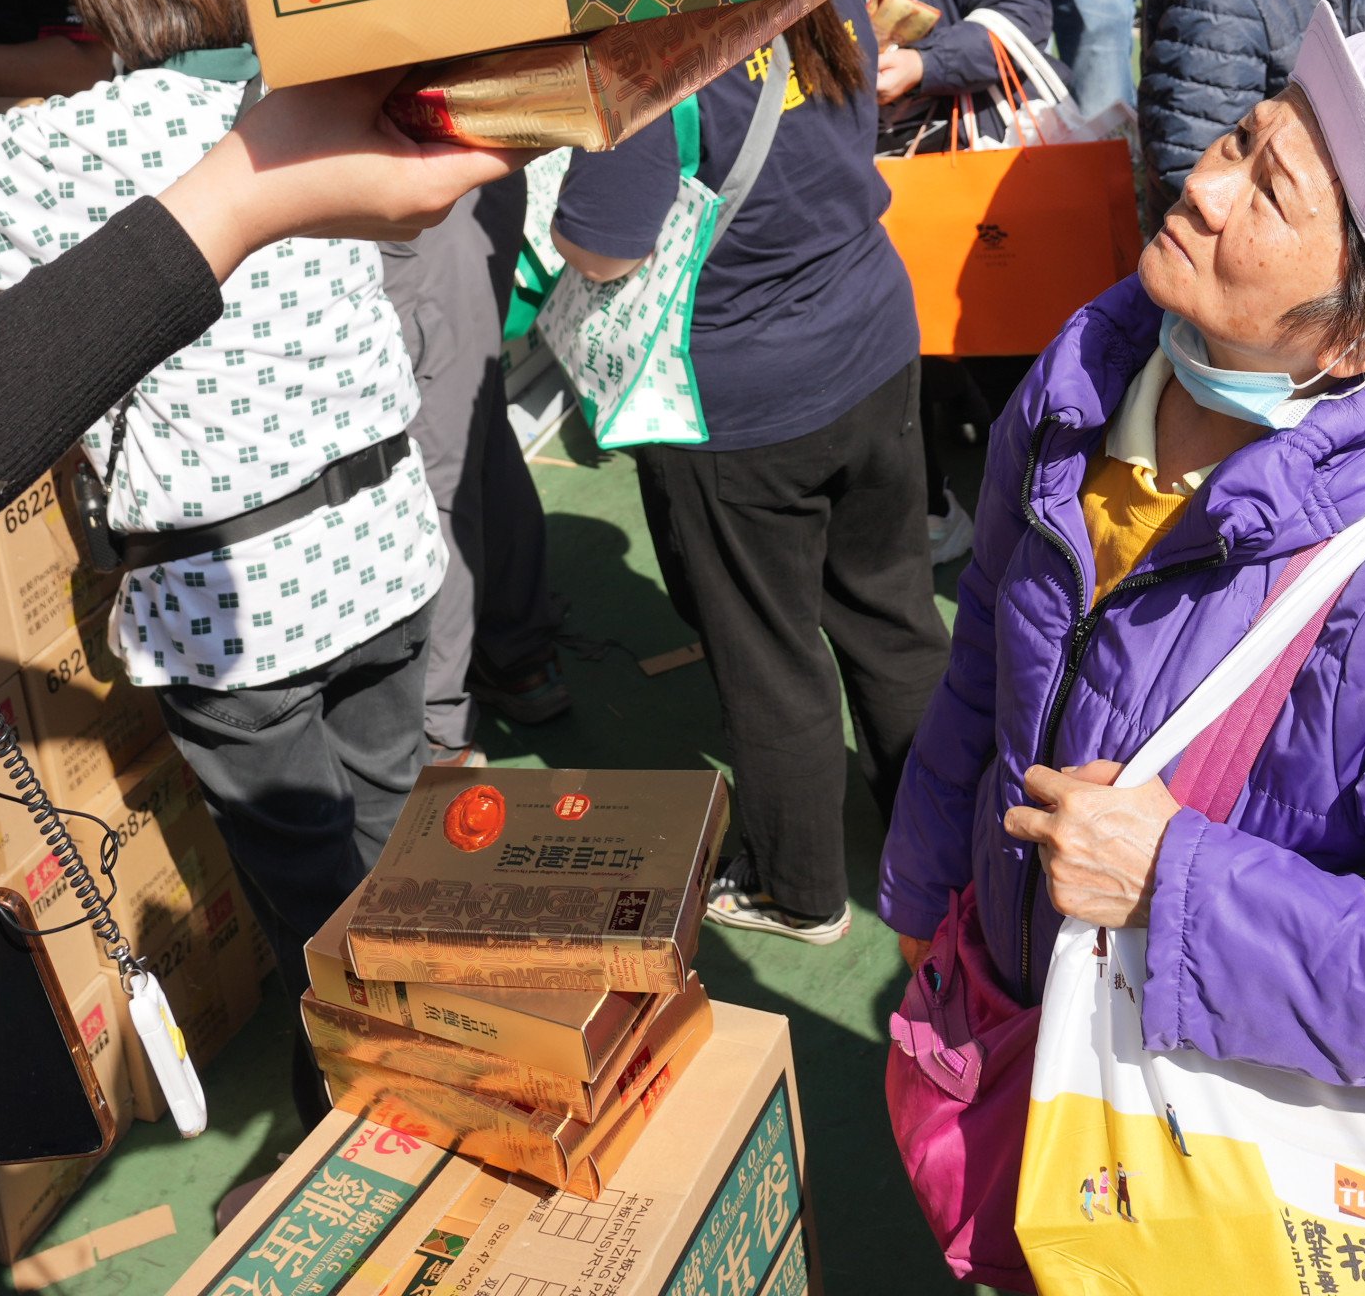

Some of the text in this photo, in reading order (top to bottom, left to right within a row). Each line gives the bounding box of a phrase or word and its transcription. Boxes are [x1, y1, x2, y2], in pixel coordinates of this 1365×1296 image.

[497, 843, 646, 869] 吉品鮑魚
[701, 1102, 783, 1253] EGG ROLLS
[346, 1187, 405, 1236] 傳統
[597, 1197, 654, 1280] PALLETIZING
[698, 1151, 791, 1296] 蛋卷
[327, 1233, 365, 1274] EGG
